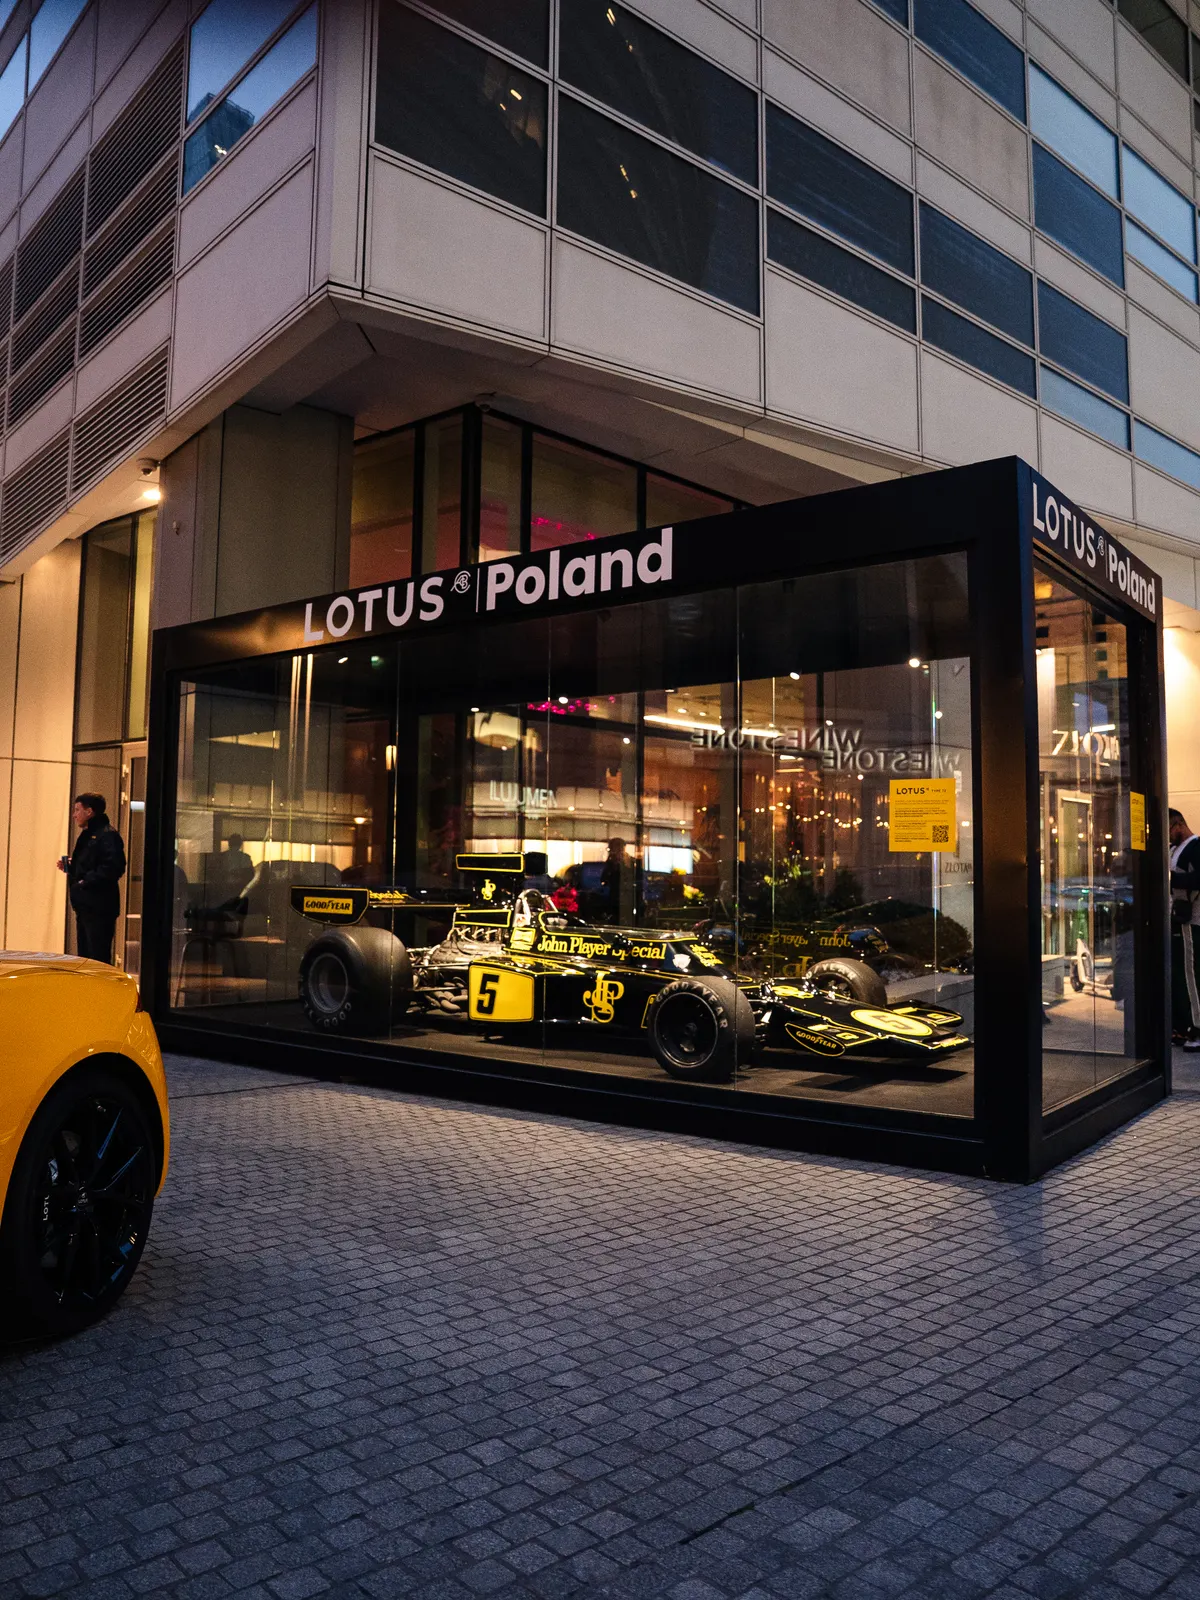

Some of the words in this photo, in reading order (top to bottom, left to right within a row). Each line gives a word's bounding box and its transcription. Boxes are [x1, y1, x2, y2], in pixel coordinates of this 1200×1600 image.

[1032, 482, 1096, 568] LOTUS
[1108, 543, 1156, 615] Poland
[304, 576, 444, 643] LOTUS
[486, 527, 673, 612] Poland
[896, 787, 925, 795] LOTUS
[305, 899, 351, 911] GOODYEAR
[537, 934, 568, 954] John
[568, 936, 612, 959] Player
[476, 973, 500, 1015] 5
